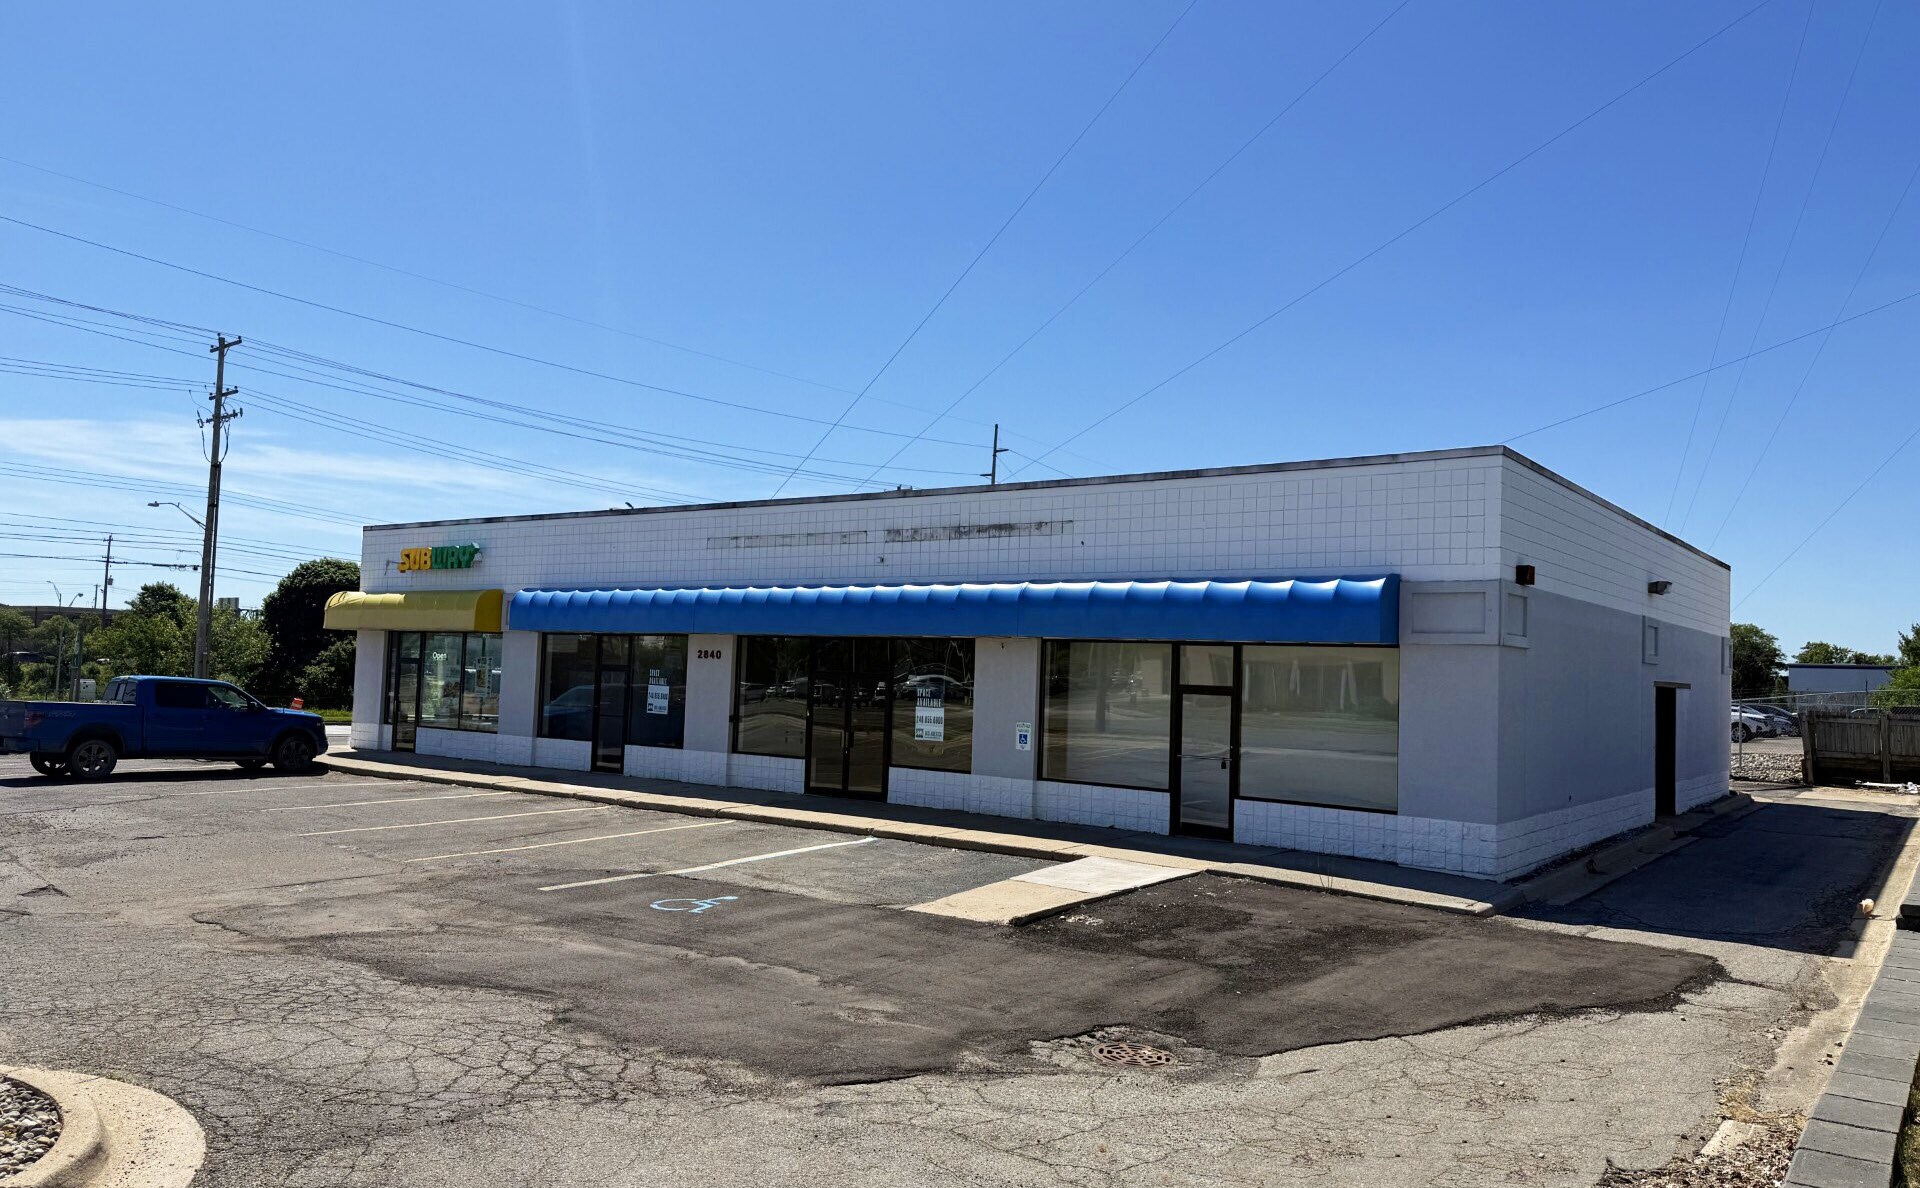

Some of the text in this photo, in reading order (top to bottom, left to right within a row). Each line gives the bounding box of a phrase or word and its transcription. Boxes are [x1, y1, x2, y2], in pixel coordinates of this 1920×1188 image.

[397, 544, 479, 571] SUBWAY
[432, 651, 447, 661] Open
[697, 650, 722, 659] 2840
